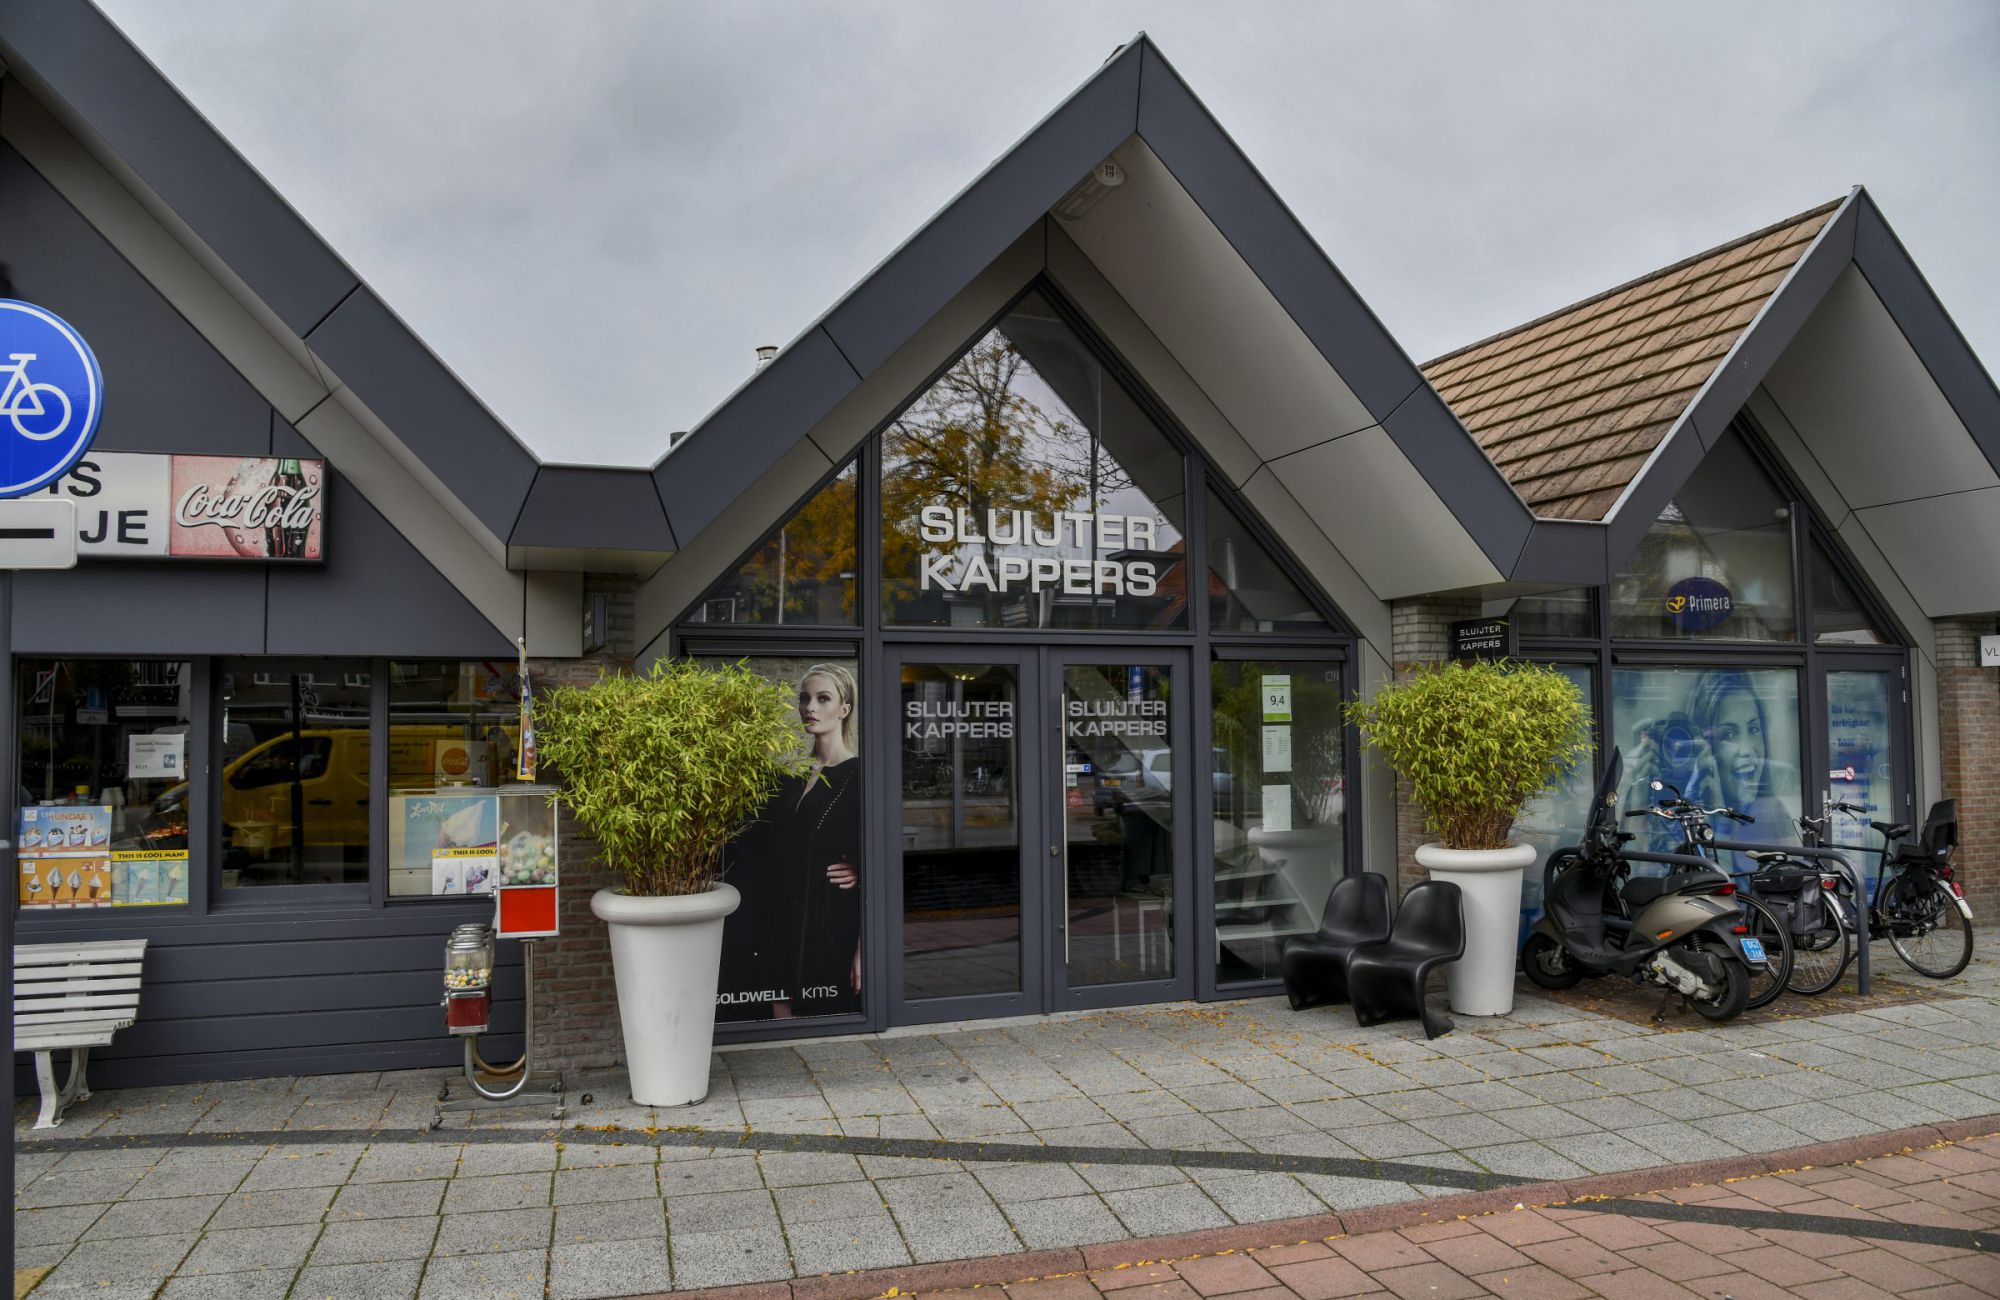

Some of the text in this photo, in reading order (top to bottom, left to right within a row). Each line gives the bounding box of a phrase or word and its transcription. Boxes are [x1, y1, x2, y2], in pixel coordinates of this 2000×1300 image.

[175, 484, 320, 529] Coca-Cola
[920, 506, 1156, 551] SLUIJTER
[921, 554, 1156, 597] KAPPERS
[1689, 595, 1731, 613] Primera
[1459, 625, 1501, 637] SLUIJTER
[1461, 640, 1501, 651] KAPPERS
[1069, 701, 1167, 717] SLUIJTER
[1270, 695, 1285, 706] 9,4
[906, 701, 1013, 718] SLUIJTER
[906, 722, 1013, 739] KAPPERS
[1069, 721, 1167, 736] KAPPERS
